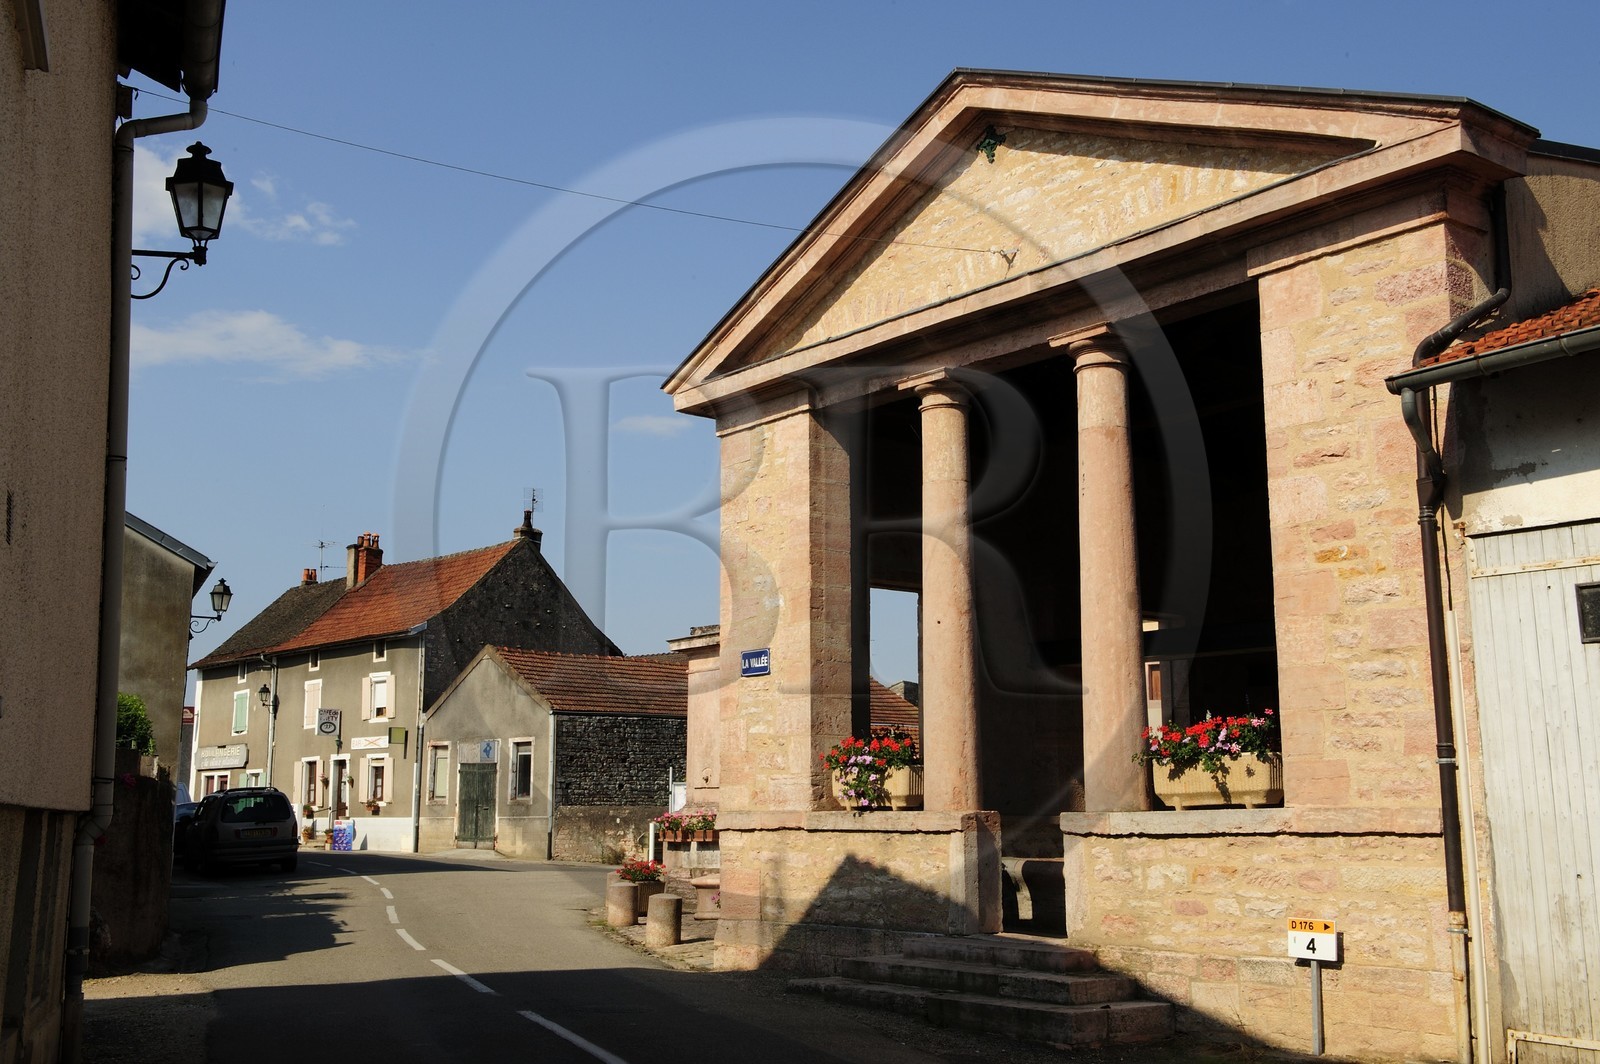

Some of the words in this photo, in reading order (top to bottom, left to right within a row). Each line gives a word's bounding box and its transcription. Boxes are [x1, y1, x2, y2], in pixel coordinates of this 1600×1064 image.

[742, 659, 749, 669] LA
[750, 654, 768, 668] VALLÉE
[1291, 920, 1297, 930] D
[1299, 921, 1314, 931] 176
[1306, 937, 1317, 954] 4
